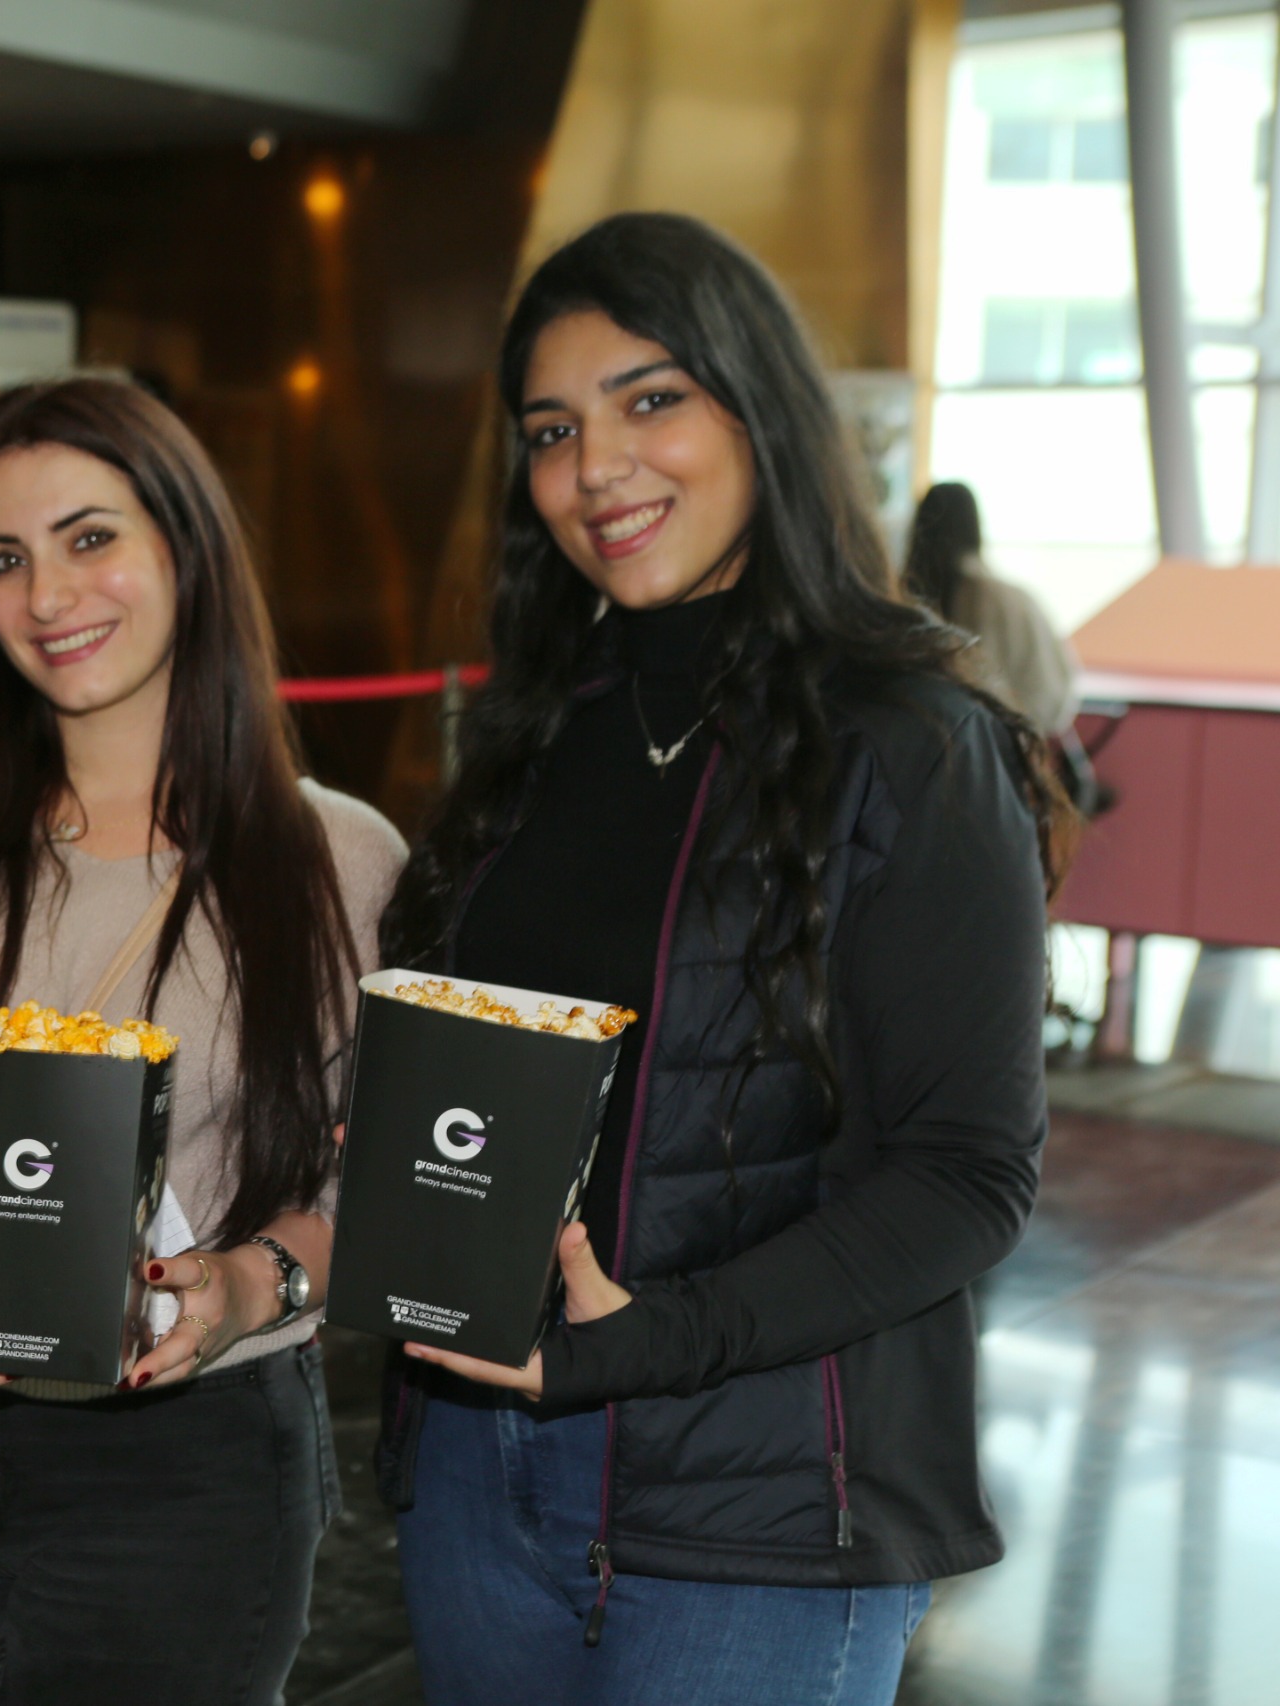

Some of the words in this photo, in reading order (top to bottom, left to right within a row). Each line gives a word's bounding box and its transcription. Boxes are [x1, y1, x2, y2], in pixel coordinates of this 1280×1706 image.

[414, 1159, 492, 1184] grandcinemas
[414, 1175, 440, 1188] always
[441, 1181, 487, 1199] entertaining
[17, 1211, 61, 1224] entertaining
[386, 1294, 470, 1321] GRANDCINEMASME.COM
[401, 1315, 457, 1335] GRANDCINEMAS
[418, 1311, 462, 1328] GCLEBANON
[11, 1342, 53, 1353] GCLEBANON
